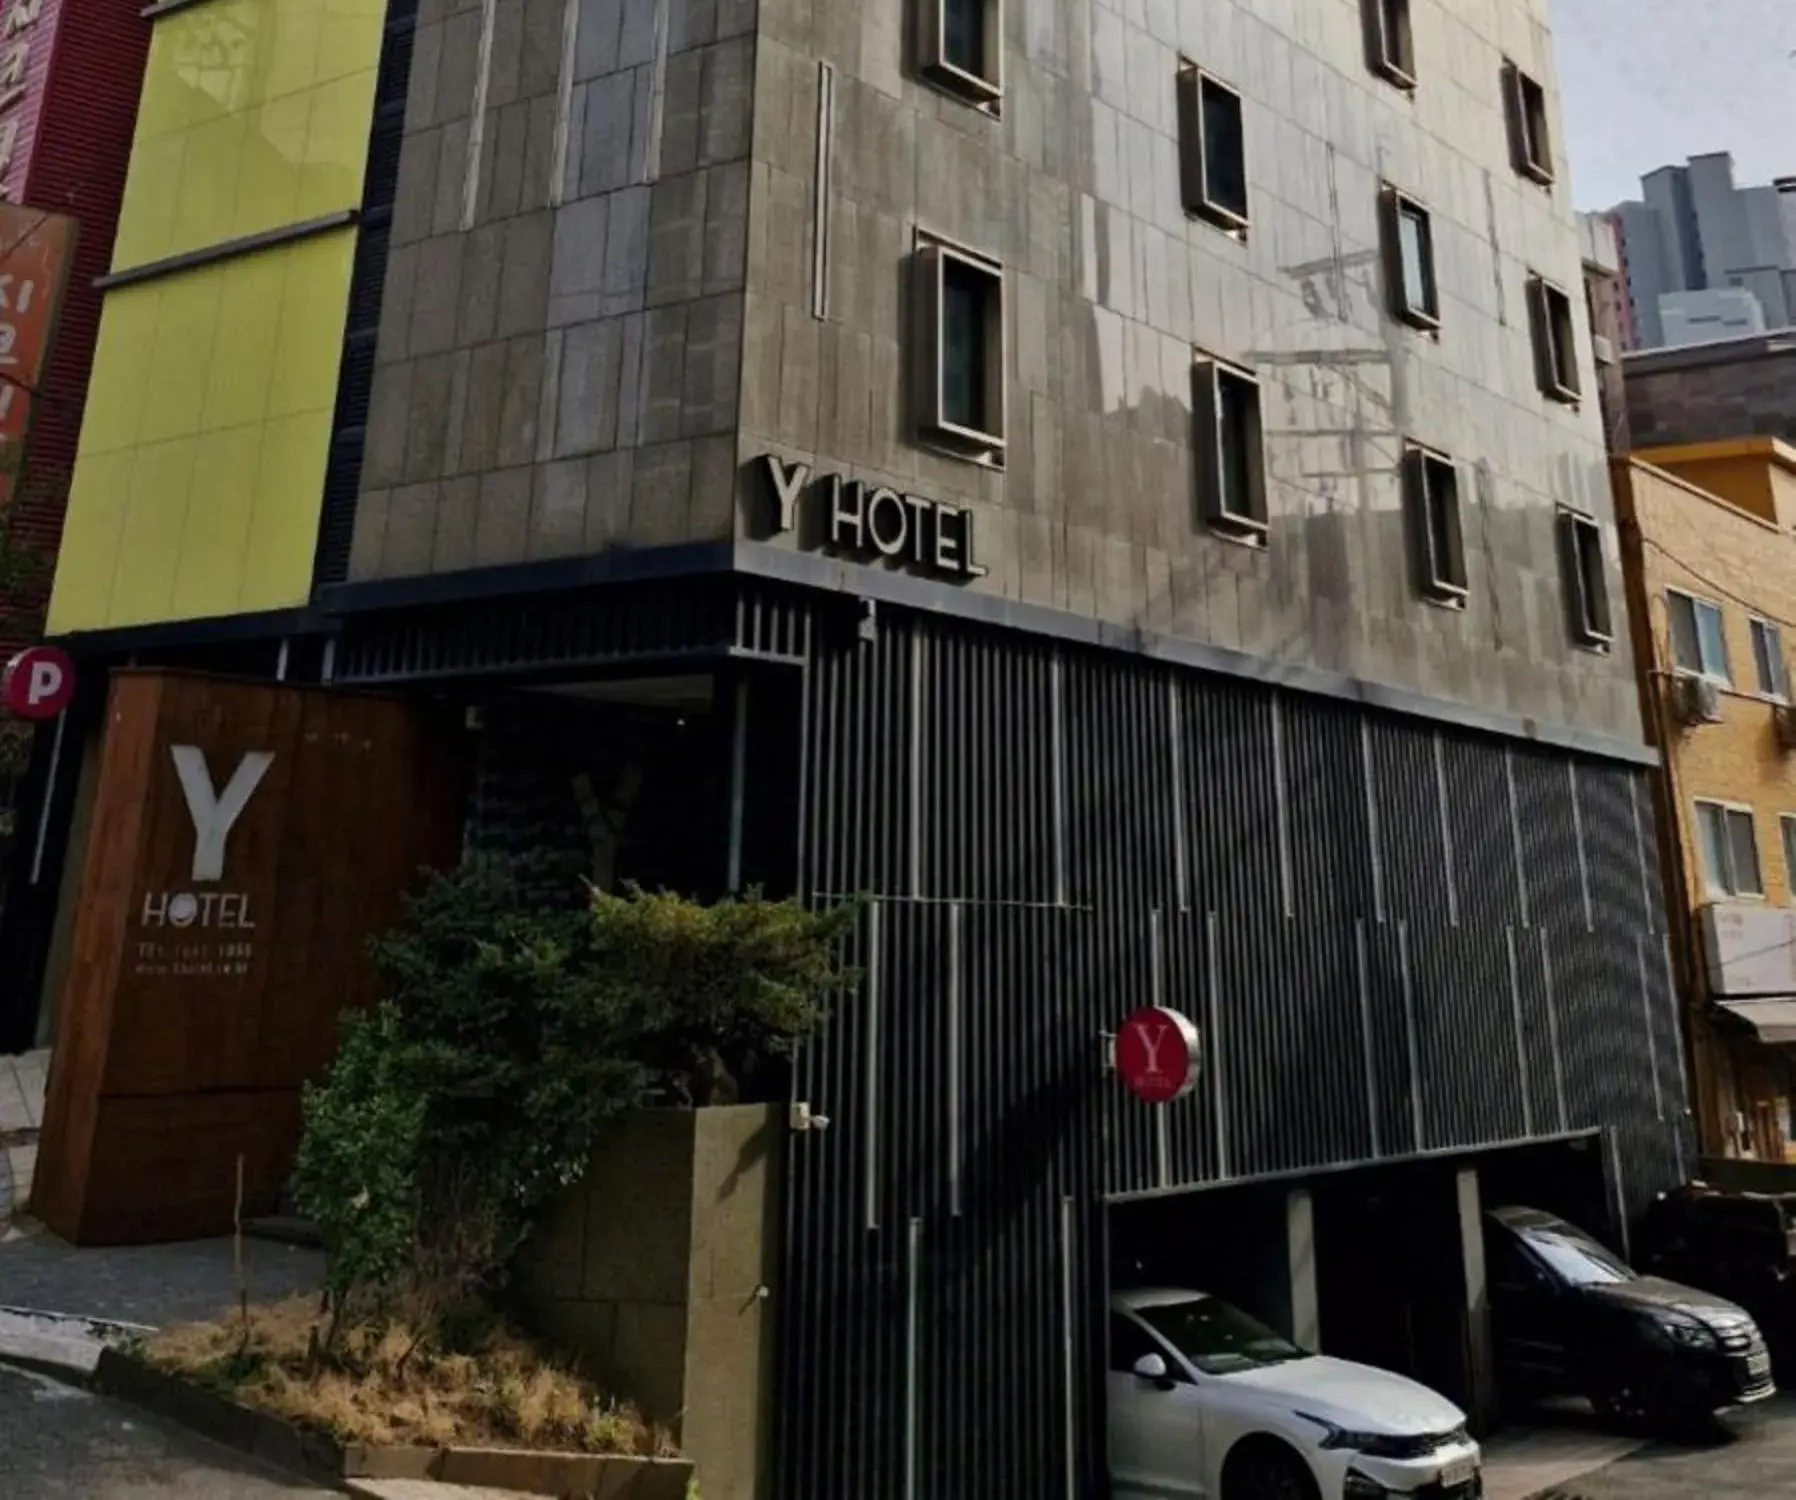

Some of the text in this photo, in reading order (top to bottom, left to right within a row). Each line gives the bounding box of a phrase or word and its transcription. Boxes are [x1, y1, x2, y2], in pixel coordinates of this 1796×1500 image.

[767, 454, 988, 575] Y HOTEL
[29, 662, 62, 704] P
[170, 745, 276, 881] Y
[140, 891, 256, 929] HOTEL
[1134, 1023, 1170, 1074] Y
